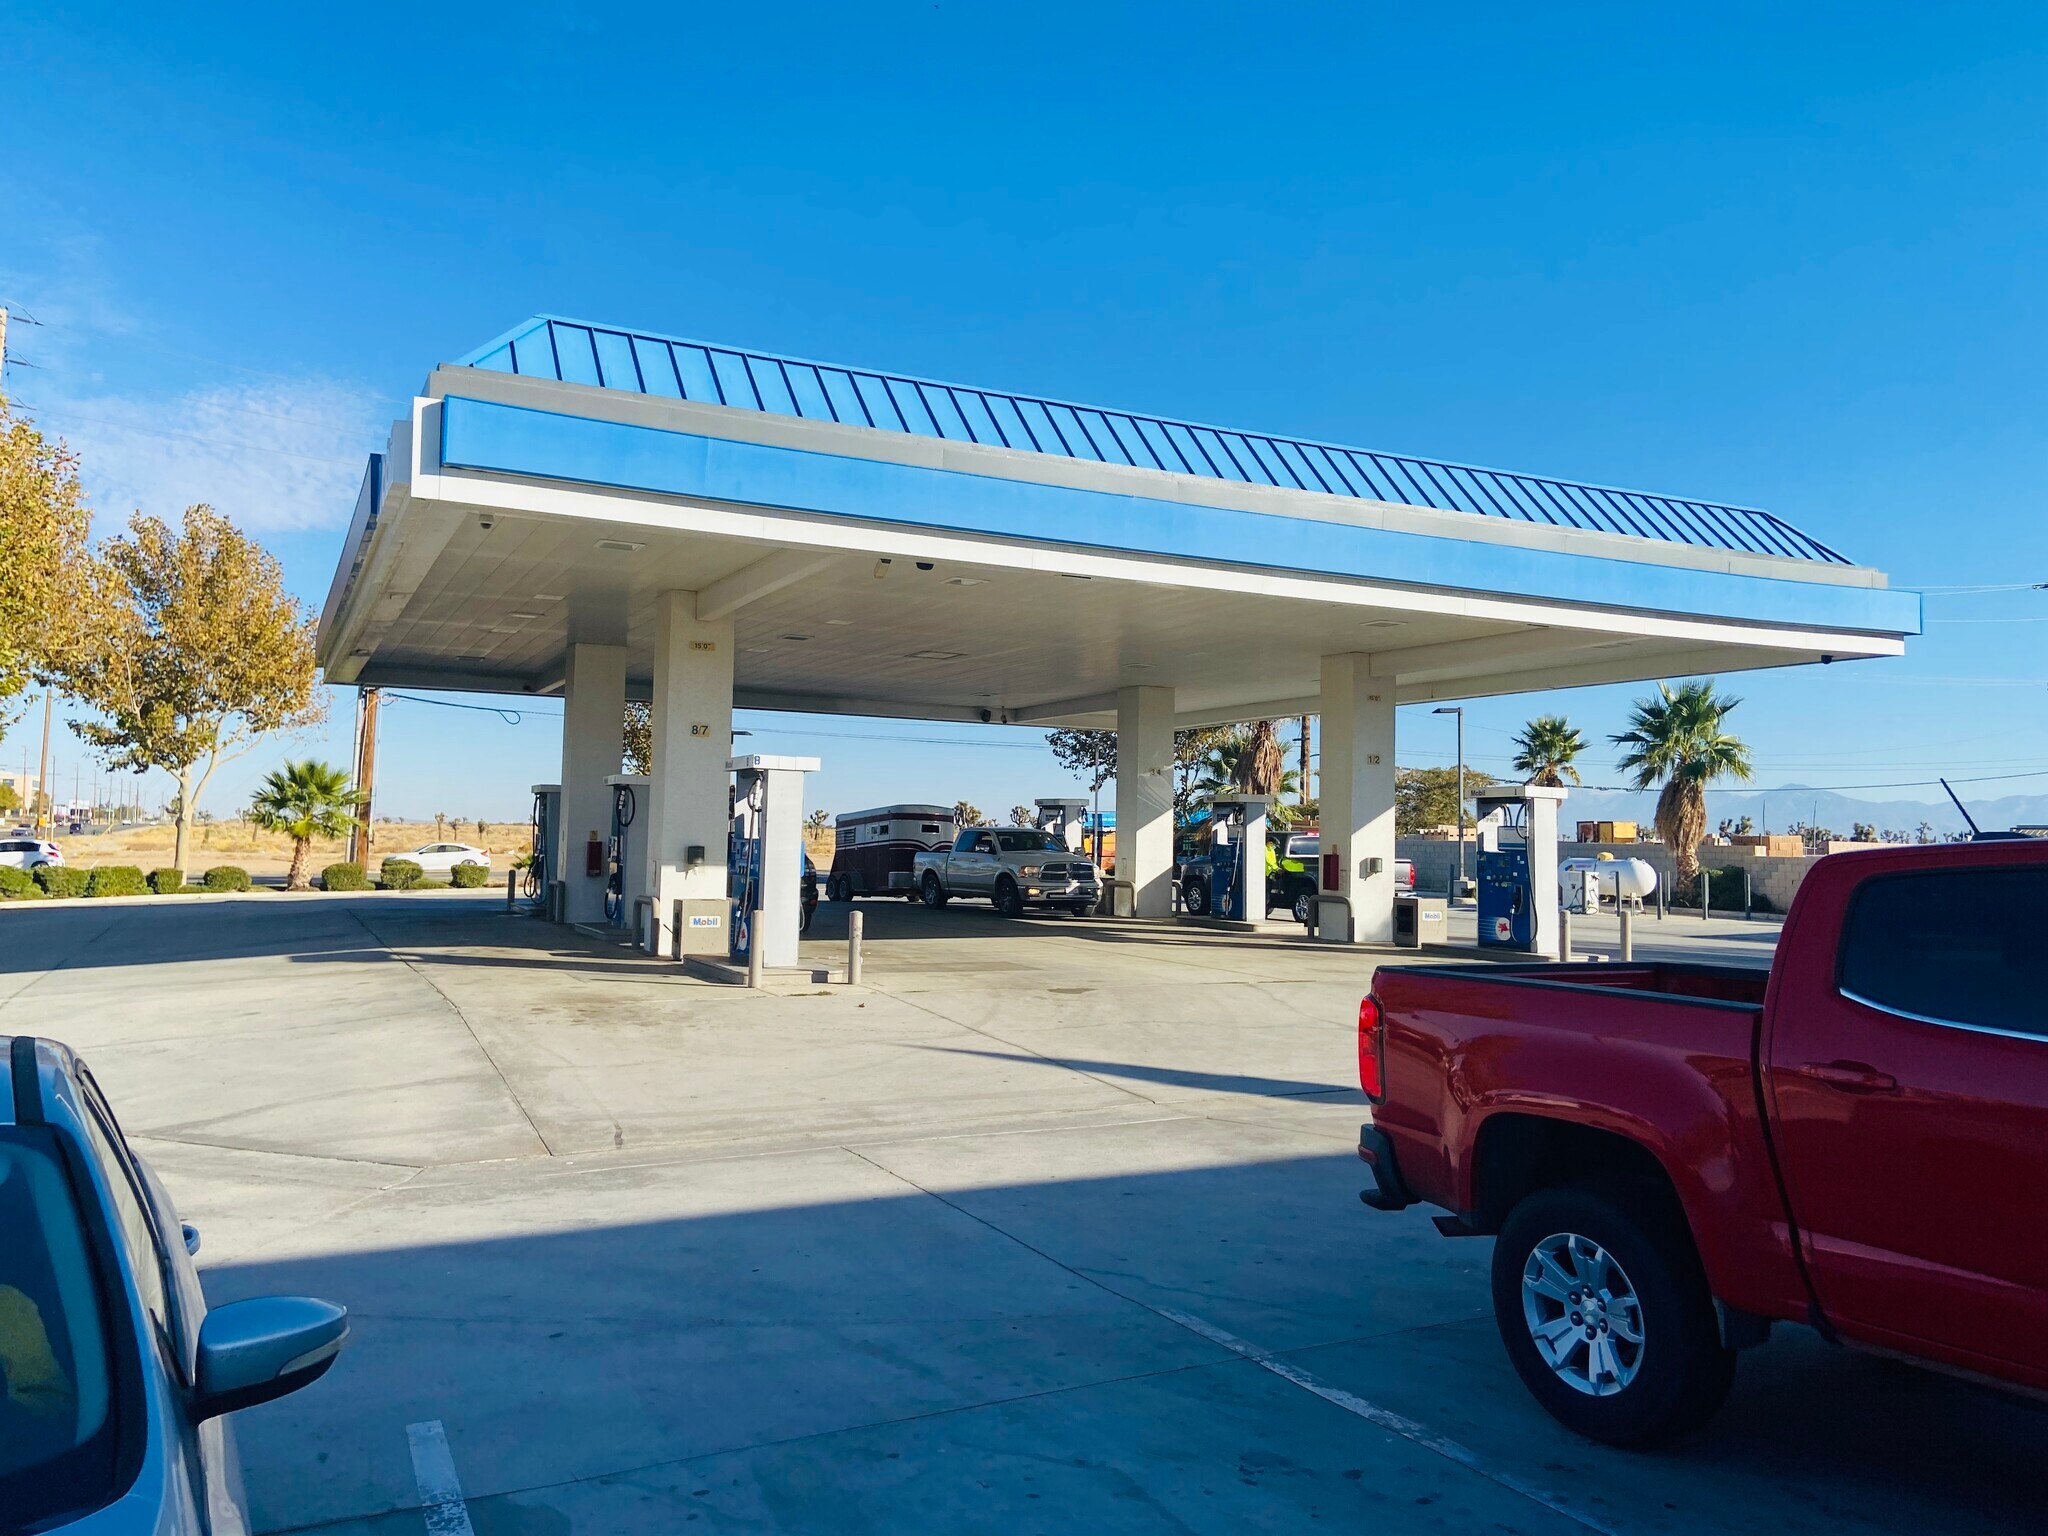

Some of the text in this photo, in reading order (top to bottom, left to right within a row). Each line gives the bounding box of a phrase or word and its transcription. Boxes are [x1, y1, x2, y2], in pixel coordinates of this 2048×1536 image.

[691, 724, 709, 736] 8/7
[754, 755, 761, 766] 8
[1424, 912, 1441, 920] Mobil
[692, 917, 718, 926] Mobil
